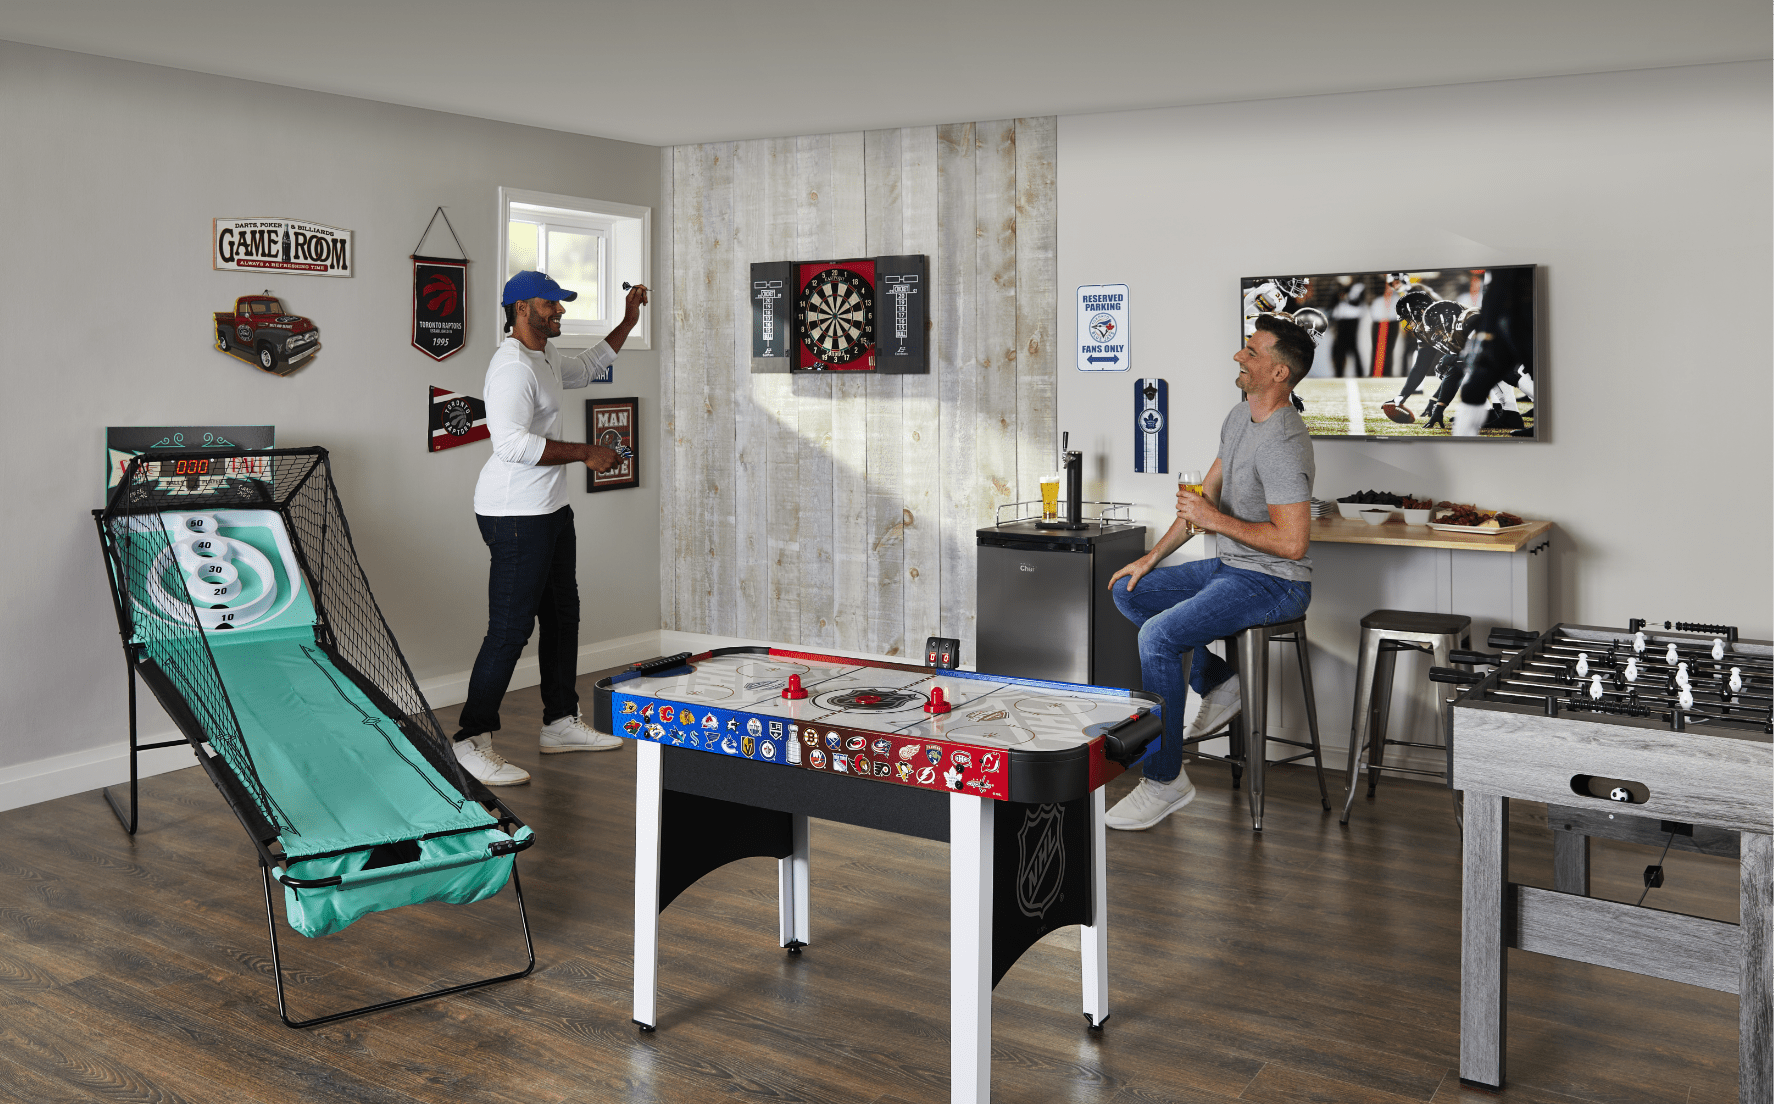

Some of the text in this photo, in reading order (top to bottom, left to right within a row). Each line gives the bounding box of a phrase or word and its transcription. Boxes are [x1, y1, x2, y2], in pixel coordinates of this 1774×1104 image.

[298, 225, 334, 236] BILLIARDS
[219, 228, 348, 270] GAME ROOM
[1083, 294, 1123, 303] RESERVED
[1085, 303, 1121, 311] PARKING
[433, 338, 449, 346] 1995
[1082, 345, 1102, 353] FANS
[445, 400, 470, 414] TORONTO
[597, 411, 628, 428] MAN
[445, 422, 470, 435] RAPTORS
[1028, 827, 1056, 898] NHL
